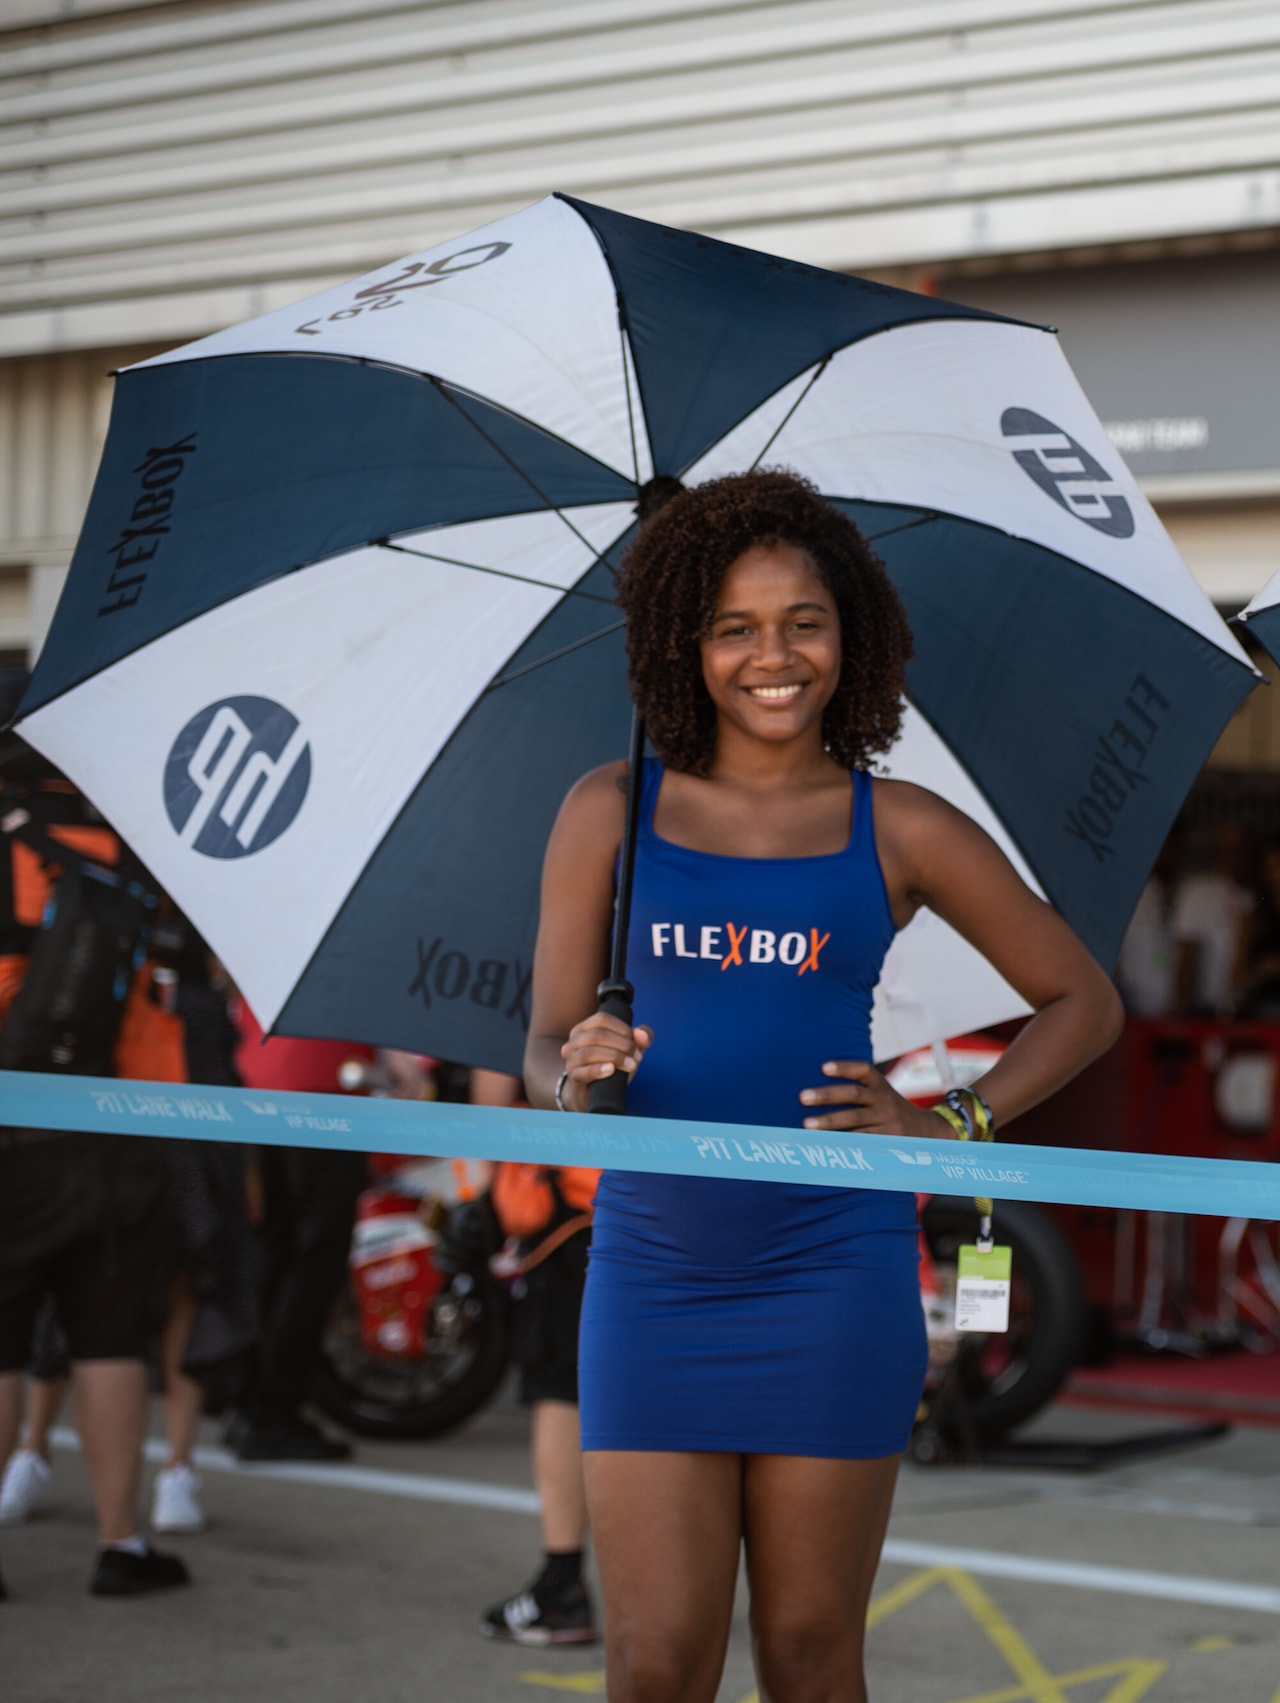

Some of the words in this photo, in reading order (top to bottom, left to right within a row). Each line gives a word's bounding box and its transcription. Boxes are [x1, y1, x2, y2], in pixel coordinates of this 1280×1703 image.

[651, 921, 831, 976] FLEXBOX
[90, 1091, 124, 1114] PIT
[125, 1093, 176, 1118] LANE
[171, 1097, 234, 1122] WALK
[284, 1114, 303, 1128] VIP
[306, 1116, 352, 1132] VILLAGE
[690, 1135, 730, 1161] PIT
[731, 1138, 802, 1167] LANE
[798, 1144, 875, 1171] WALK
[940, 1165, 965, 1179] VIP
[966, 1167, 1029, 1184] VILLAGE
